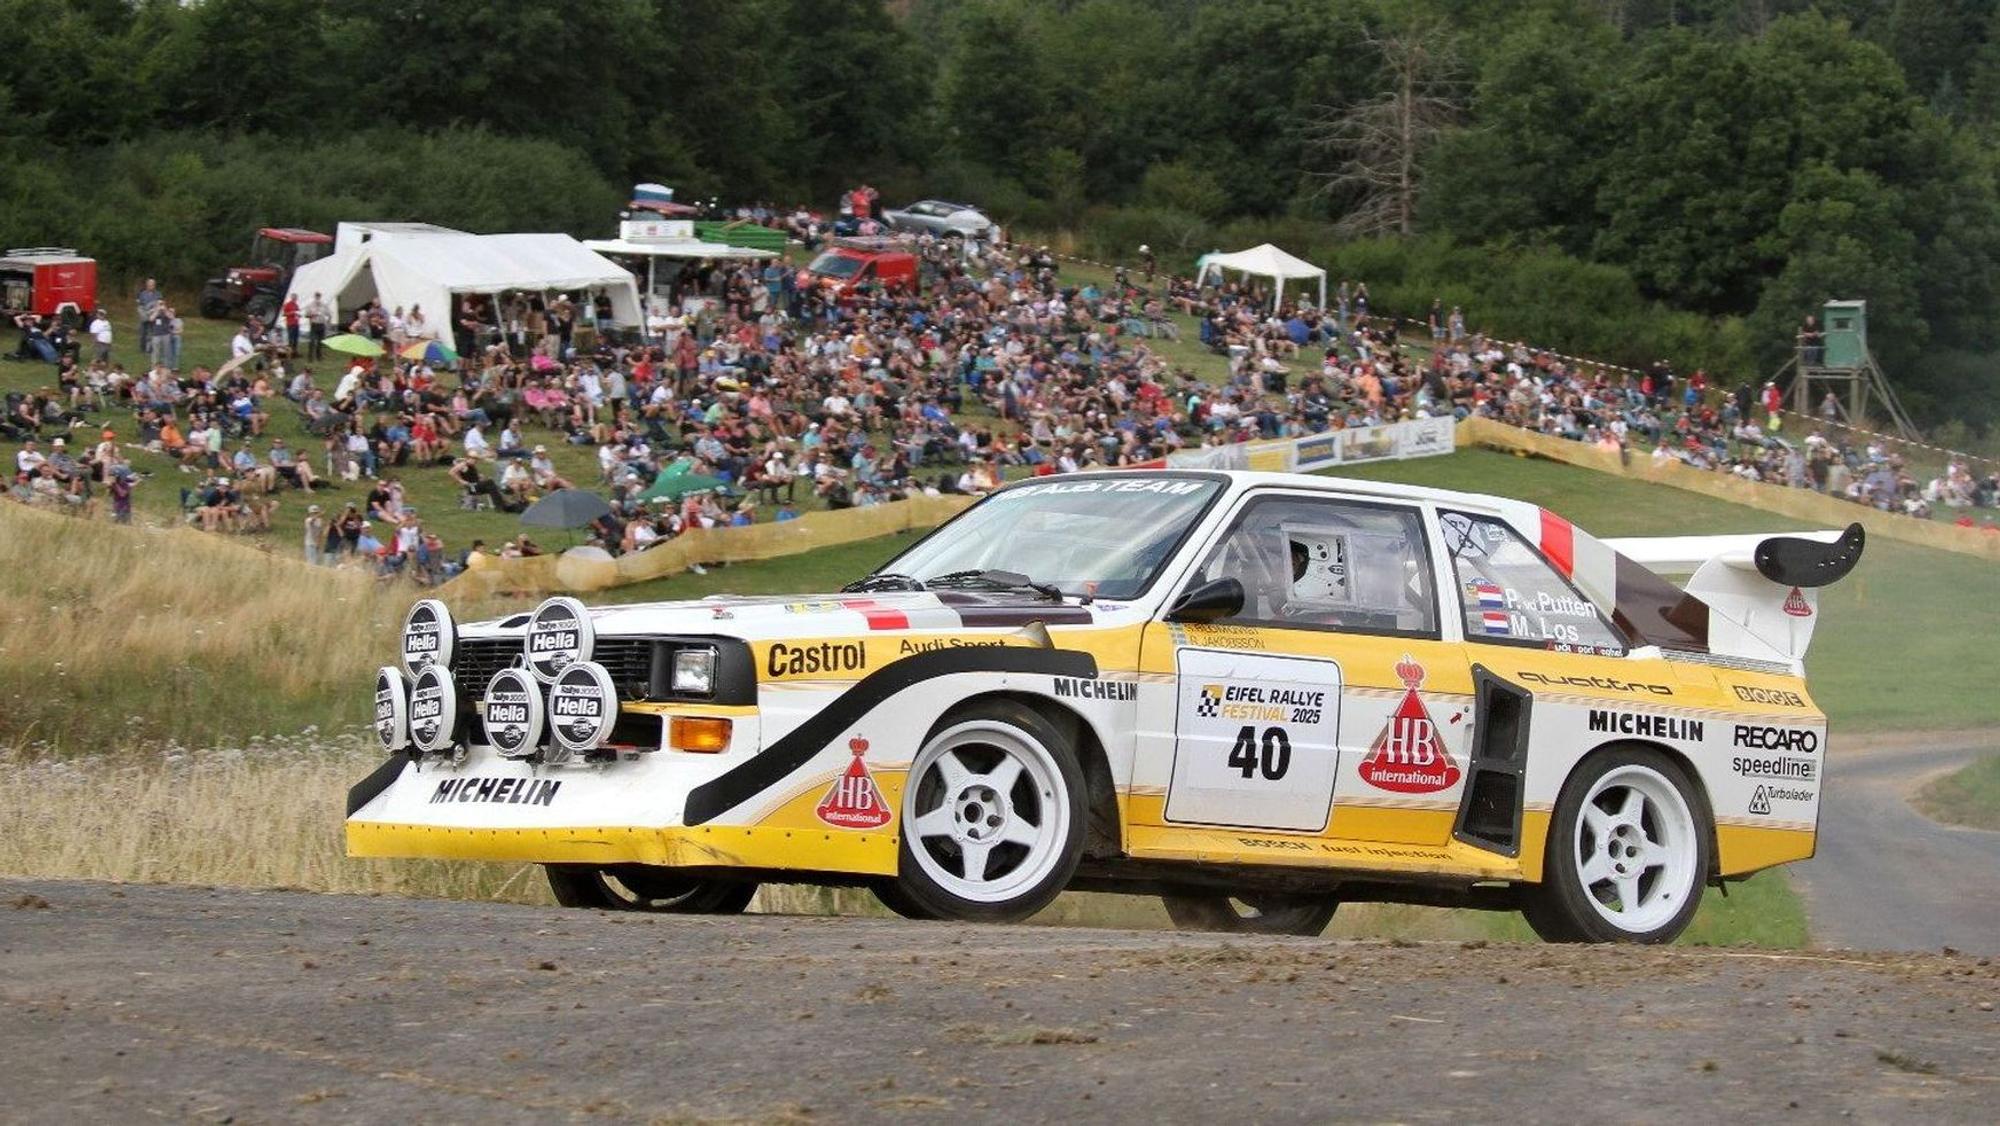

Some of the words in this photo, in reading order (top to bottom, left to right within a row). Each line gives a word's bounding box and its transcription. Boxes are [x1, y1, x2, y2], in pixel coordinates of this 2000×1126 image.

[1102, 479, 1204, 495] TEAM
[1537, 591, 1597, 618] Putten
[1510, 613, 1536, 638] M.
[1540, 617, 1579, 641] Los
[407, 634, 437, 651] Hella
[533, 632, 575, 651] Hella
[900, 638, 945, 654] Audi
[769, 641, 866, 678] Castrol
[1054, 678, 1138, 701] MICHELIN
[1517, 671, 1673, 695] quattro
[557, 697, 598, 715] Hella
[1225, 686, 1266, 703] EIFEL
[1269, 689, 1325, 707] RALLYE
[413, 699, 440, 719] Hella
[490, 704, 526, 721] Hella
[1222, 703, 1288, 721] FESTIVAL
[1291, 707, 1321, 724] 2025
[1588, 710, 1704, 742] MICHELIN
[1386, 715, 1435, 766] HB
[1733, 724, 1818, 753] RECARO
[1228, 726, 1292, 780] 40
[1370, 766, 1447, 786] international
[1732, 756, 1811, 777] speedline
[429, 777, 562, 806] MICHELIN
[837, 774, 873, 810] HB
[1768, 786, 1814, 802] Turbolader
[1238, 837, 1313, 851] BOSCH
